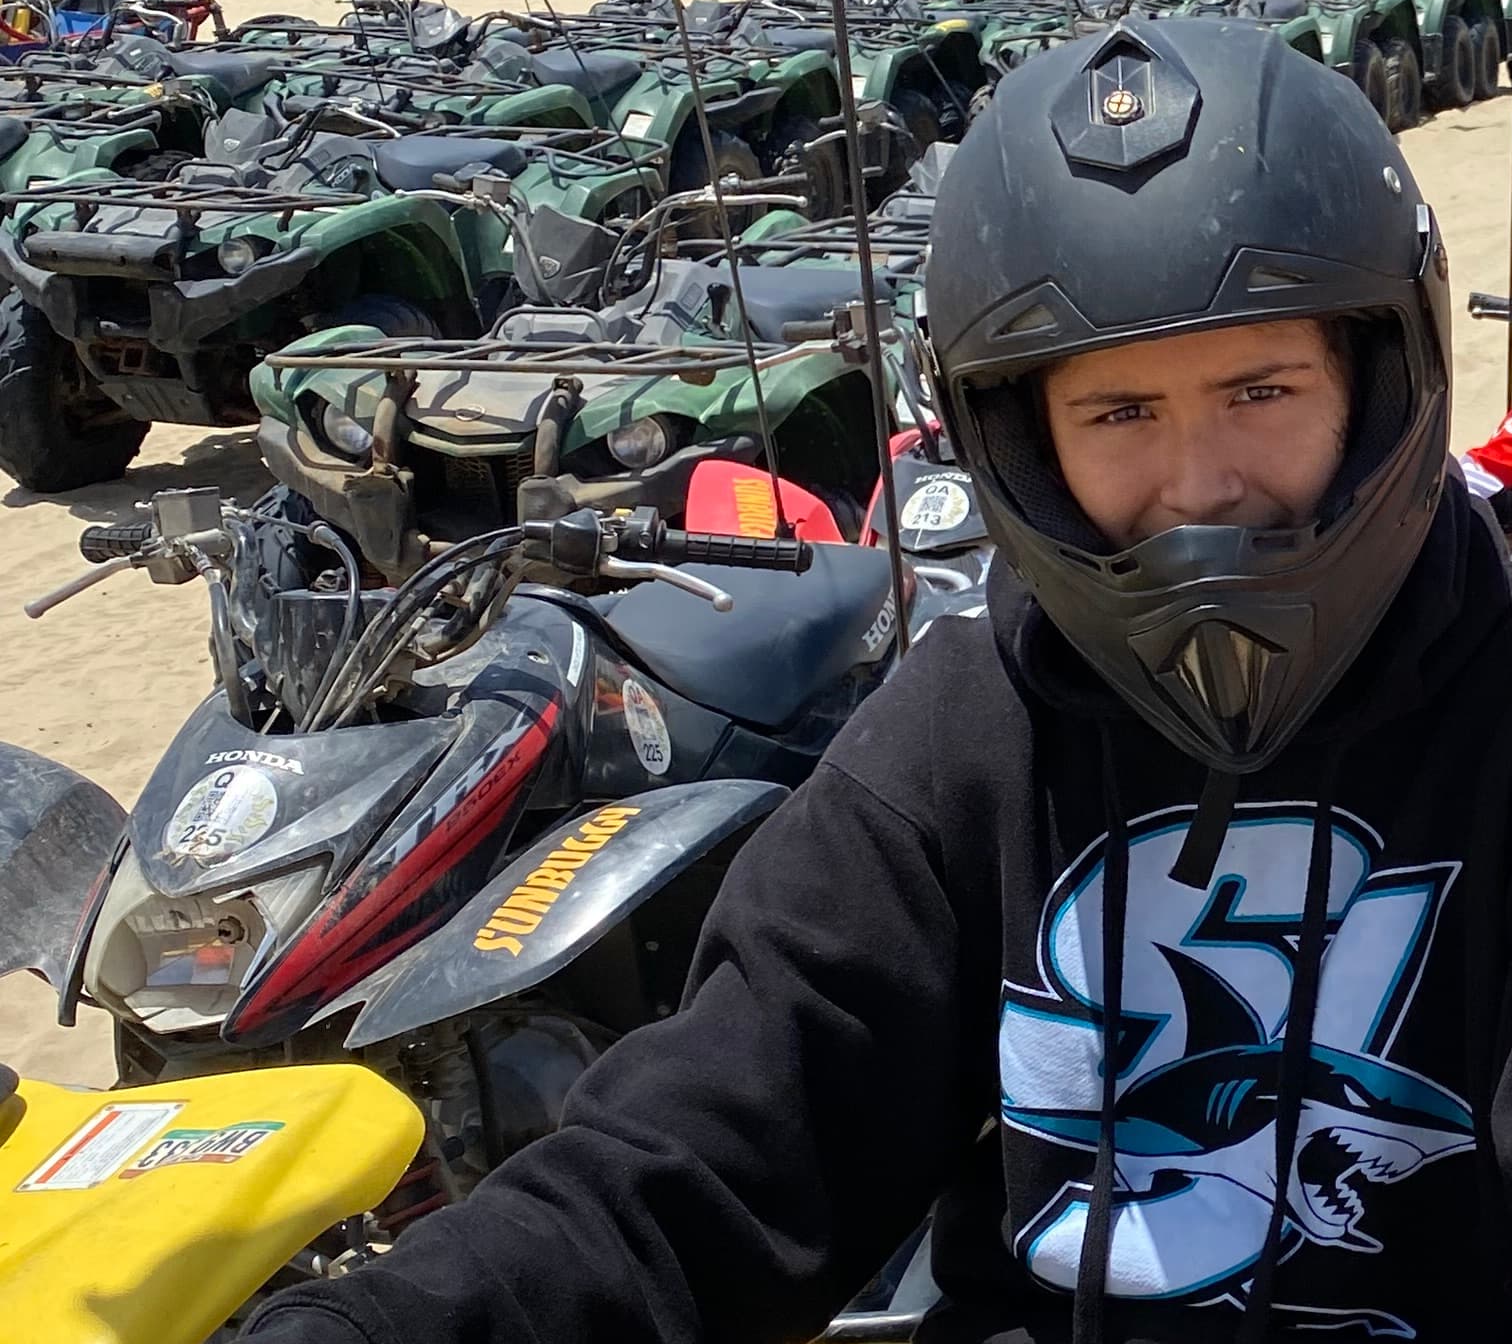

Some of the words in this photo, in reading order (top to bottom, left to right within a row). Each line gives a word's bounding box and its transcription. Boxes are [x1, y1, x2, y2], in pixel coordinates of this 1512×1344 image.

[911, 513, 942, 526] 213
[862, 586, 896, 652] HON
[205, 749, 305, 776] HONDA
[643, 742, 664, 763] 225
[472, 807, 642, 957] SUNBUGGY
